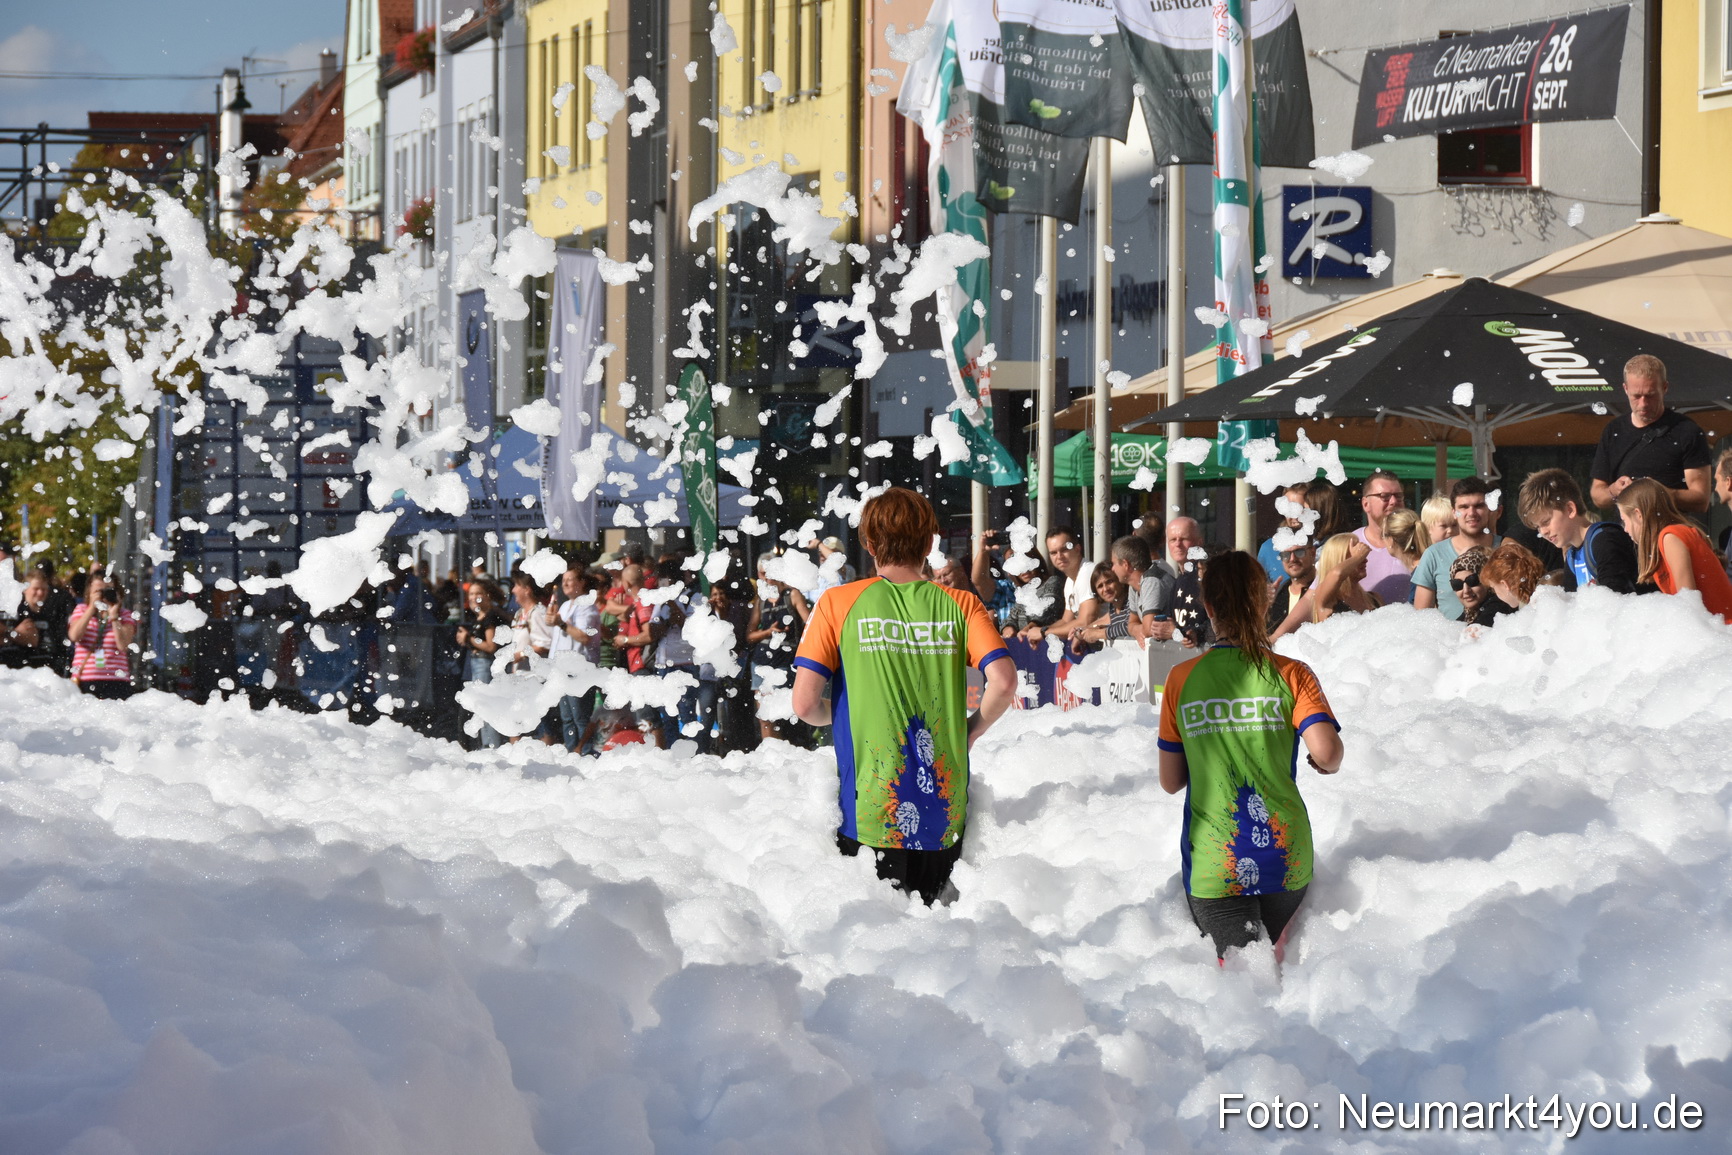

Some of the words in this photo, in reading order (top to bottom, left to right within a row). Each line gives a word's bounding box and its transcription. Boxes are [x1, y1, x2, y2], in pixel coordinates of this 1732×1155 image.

[1539, 24, 1577, 73] 28.
[1403, 72, 1525, 123] KULTURNACHT
[1532, 79, 1568, 111] SEPT.
[857, 617, 957, 646] BOCK
[859, 644, 889, 654] inspired
[890, 644, 900, 654] by
[902, 646, 923, 655] smart
[1181, 697, 1285, 729] BOCK
[1214, 725, 1224, 733] by
